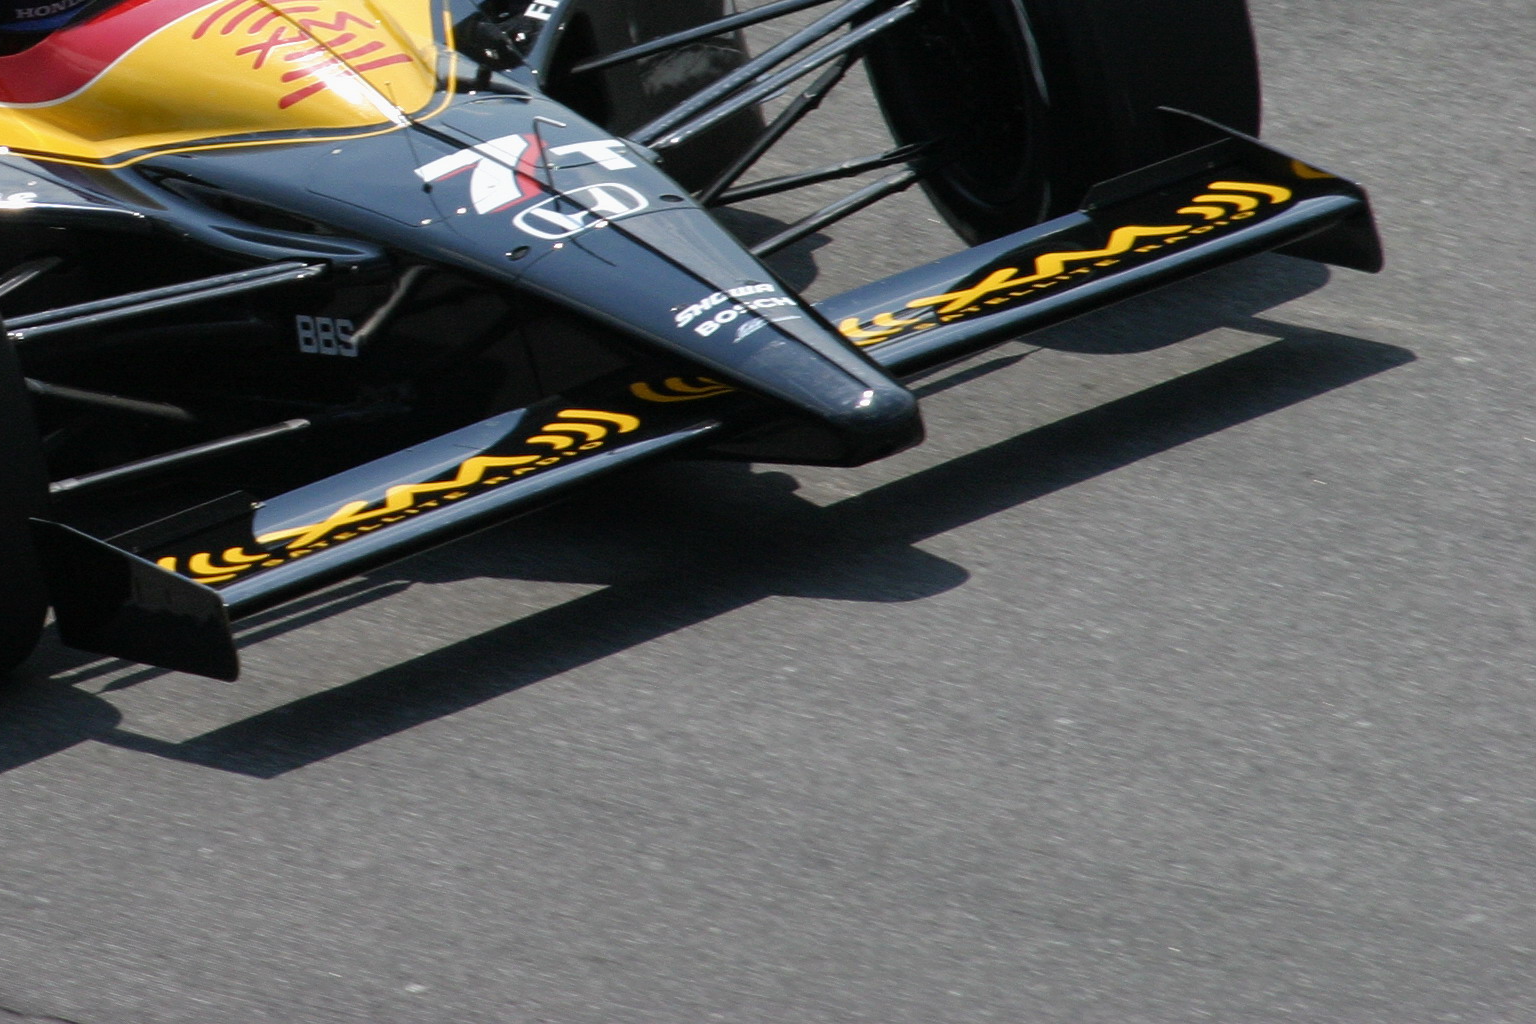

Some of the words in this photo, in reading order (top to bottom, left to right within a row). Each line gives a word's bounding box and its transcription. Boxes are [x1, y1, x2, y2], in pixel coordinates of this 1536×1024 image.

[414, 134, 530, 215] 7
[906, 225, 1193, 313] XM
[296, 314, 359, 357] BBS
[694, 297, 797, 337] BOSCH
[255, 455, 542, 550] XM
